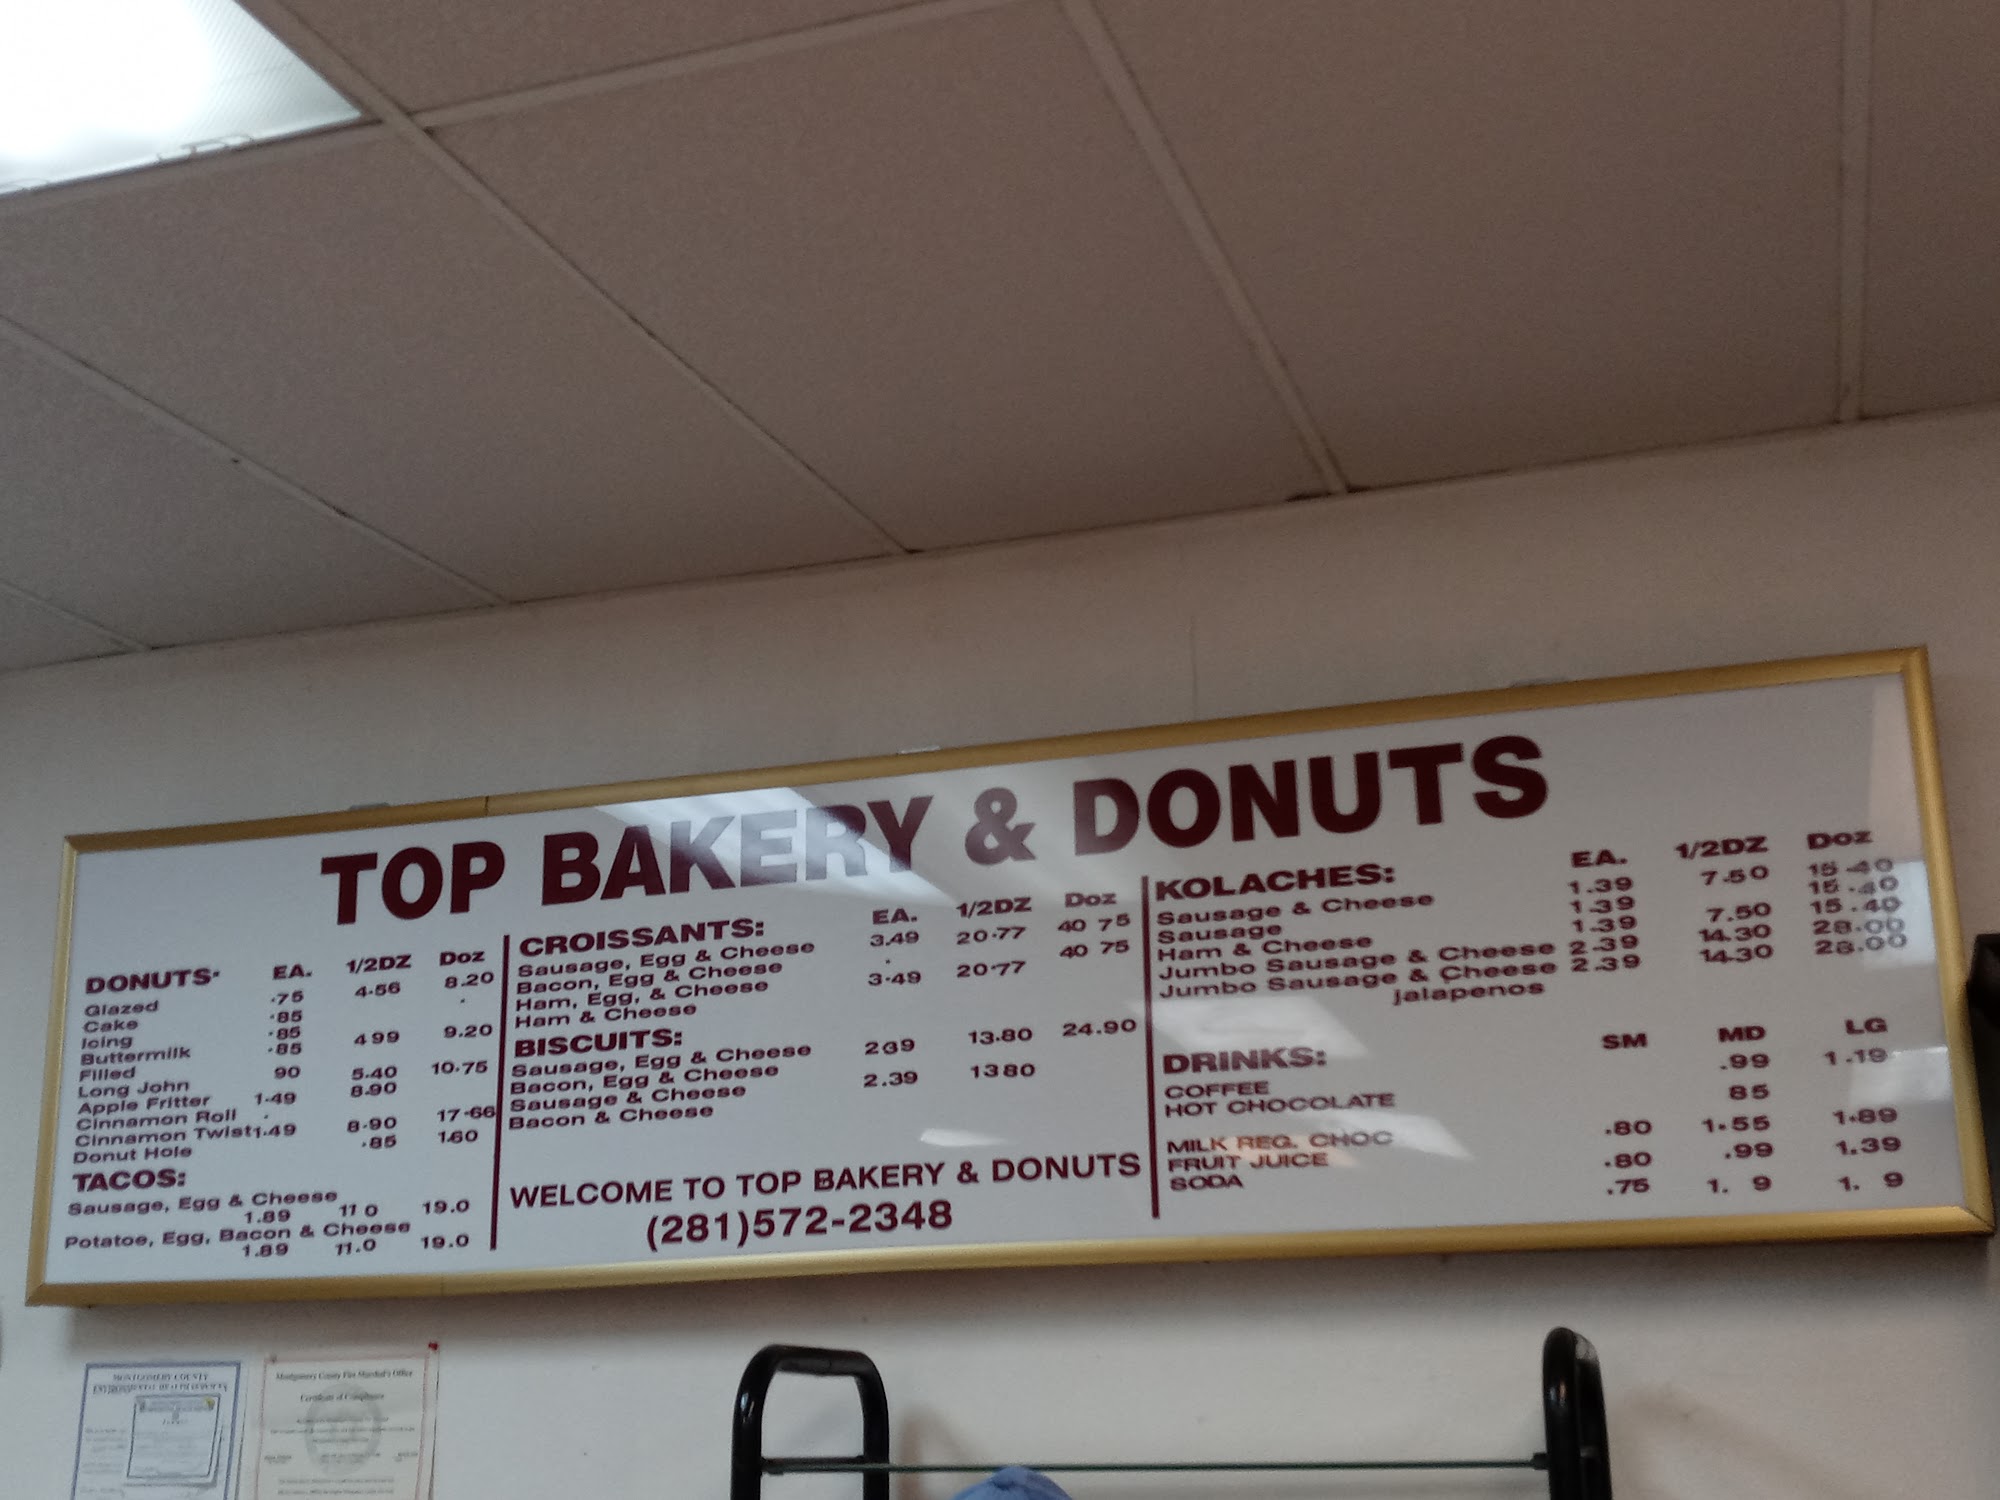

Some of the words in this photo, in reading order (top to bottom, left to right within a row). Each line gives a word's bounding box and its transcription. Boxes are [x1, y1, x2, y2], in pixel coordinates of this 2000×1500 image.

[322, 840, 506, 927] TOP
[541, 786, 926, 905] BAKERY
[964, 787, 1035, 866] &
[1072, 734, 1549, 856] DONUTS
[1806, 830, 1873, 850] Doz
[1674, 835, 1769, 860] 1/2DZ
[1570, 849, 1628, 868] EA.
[1155, 863, 1396, 902] KOLACHES:
[1568, 876, 1634, 895] 1.39
[1700, 865, 1769, 886] 7.50
[956, 896, 1032, 919] 1/2DZ
[1065, 892, 1117, 908] Doz
[872, 907, 917, 926] EA.
[1156, 905, 1282, 926] Sausage
[1292, 901, 1312, 916] &
[1320, 895, 1435, 913] Cheese
[1706, 902, 1772, 923] 7.50
[519, 917, 766, 958] CROISSANTS:
[870, 930, 919, 947] 3.49
[1157, 923, 1282, 945] Sausage
[439, 951, 485, 967] Doz
[1157, 947, 1222, 962] Ham
[1232, 942, 1252, 957] &
[1261, 936, 1373, 955] Cheese
[346, 953, 412, 974] 1/2DZ
[518, 959, 631, 979] Sausage,
[640, 952, 686, 969] Egg
[695, 949, 711, 963] &
[720, 942, 815, 961] Cheese
[1158, 962, 1257, 981] Jumbo
[1265, 954, 1397, 973] Sausage
[1407, 949, 1429, 964] &
[1439, 943, 1556, 962] Cheese
[272, 963, 312, 980] EA.
[444, 971, 495, 989] 8.20
[516, 978, 599, 996] Bacon,
[608, 973, 654, 989] Egg
[663, 969, 680, 983] &
[688, 961, 782, 980] Cheese
[1159, 981, 1258, 999] Jumbo
[1266, 973, 1398, 992] Sausage
[1408, 968, 1430, 983] &
[1439, 962, 1558, 982] Cheese
[354, 981, 401, 998] 4.56
[515, 997, 577, 1012] Ham,
[587, 991, 640, 1008] Egg,
[649, 988, 666, 1001] &
[674, 981, 768, 999] Cheese
[1392, 981, 1545, 1006] jalapenos
[84, 1000, 159, 1018] Glazed
[515, 1014, 570, 1029] Ham
[579, 1010, 596, 1024] &
[603, 1003, 697, 1022] Cheese
[82, 1019, 139, 1034] Cake
[444, 1023, 493, 1039] 9.20
[968, 1027, 1033, 1045] 13.80
[1062, 1018, 1137, 1037] 24.90
[1717, 1025, 1767, 1043] MD
[1845, 1017, 1888, 1035] LG
[81, 1035, 133, 1050] Icing
[514, 1028, 682, 1059] BISCUITS:
[1601, 1032, 1648, 1050] SM
[80, 1046, 191, 1066] Buttermilk
[511, 1059, 625, 1078] Sausage,
[635, 1054, 681, 1071] Egg
[690, 1051, 707, 1065] &
[716, 1045, 811, 1063] Cheese
[1163, 1047, 1327, 1075] DRINKS:
[79, 1066, 136, 1082] Filled
[351, 1065, 398, 1081] 5.40
[431, 1060, 488, 1075] 10.75
[510, 1079, 593, 1096] Bacon,
[603, 1074, 649, 1091] Egg
[658, 1071, 675, 1085] &
[683, 1065, 779, 1083] Cheese
[864, 1070, 918, 1088] 2.39
[78, 1084, 130, 1099] Long
[137, 1080, 190, 1095] John
[350, 1081, 397, 1098] 8.90
[510, 1094, 618, 1113] Sausage
[626, 1091, 642, 1105] &
[651, 1085, 746, 1103] Cheese
[1164, 1080, 1270, 1100] COFFEE
[78, 1101, 139, 1117] Apple
[146, 1095, 211, 1110] Fritter
[1164, 1101, 1218, 1118] HOT
[1226, 1091, 1395, 1116] CHOCOLATE
[76, 1113, 188, 1131] Cinnamon
[195, 1108, 237, 1123] Roll
[347, 1116, 397, 1133] 8.90
[508, 1114, 585, 1130] Bacon
[594, 1110, 611, 1124] &
[619, 1105, 714, 1123] Cheese
[1701, 1114, 1771, 1133] 1.55
[1832, 1107, 1898, 1125] 1.89
[75, 1131, 186, 1148] Cinnamon
[1166, 1136, 1227, 1154] MILK
[1237, 1134, 1298, 1150] REG.
[1308, 1131, 1392, 1148] CHOC
[1835, 1136, 1901, 1155] 1.39
[73, 1148, 137, 1165] Donut
[144, 1146, 193, 1160] Hole
[1167, 1155, 1241, 1173] FRUIT
[1249, 1152, 1329, 1170] JUICE
[72, 1167, 186, 1193] TACOS:
[510, 1179, 673, 1209] WELCOME
[683, 1175, 726, 1201] TO
[736, 1170, 802, 1198] TOP
[814, 1161, 946, 1193] BAKERY
[956, 1160, 980, 1185] &
[992, 1152, 1142, 1183] DONUTS
[1169, 1173, 1244, 1192] SODA
[68, 1201, 170, 1216] Sausage,
[178, 1196, 221, 1212] Egg
[228, 1193, 244, 1208] &
[251, 1190, 338, 1206] Cheese
[244, 1209, 291, 1224] 1.89
[647, 1198, 952, 1251] (281)572-2348
[64, 1234, 154, 1249] Potatoe,
[162, 1231, 210, 1247] Egg,
[219, 1227, 291, 1242] Bacon
[299, 1224, 315, 1238] &
[323, 1222, 411, 1237] Cheese
[242, 1242, 289, 1258] 1.89
